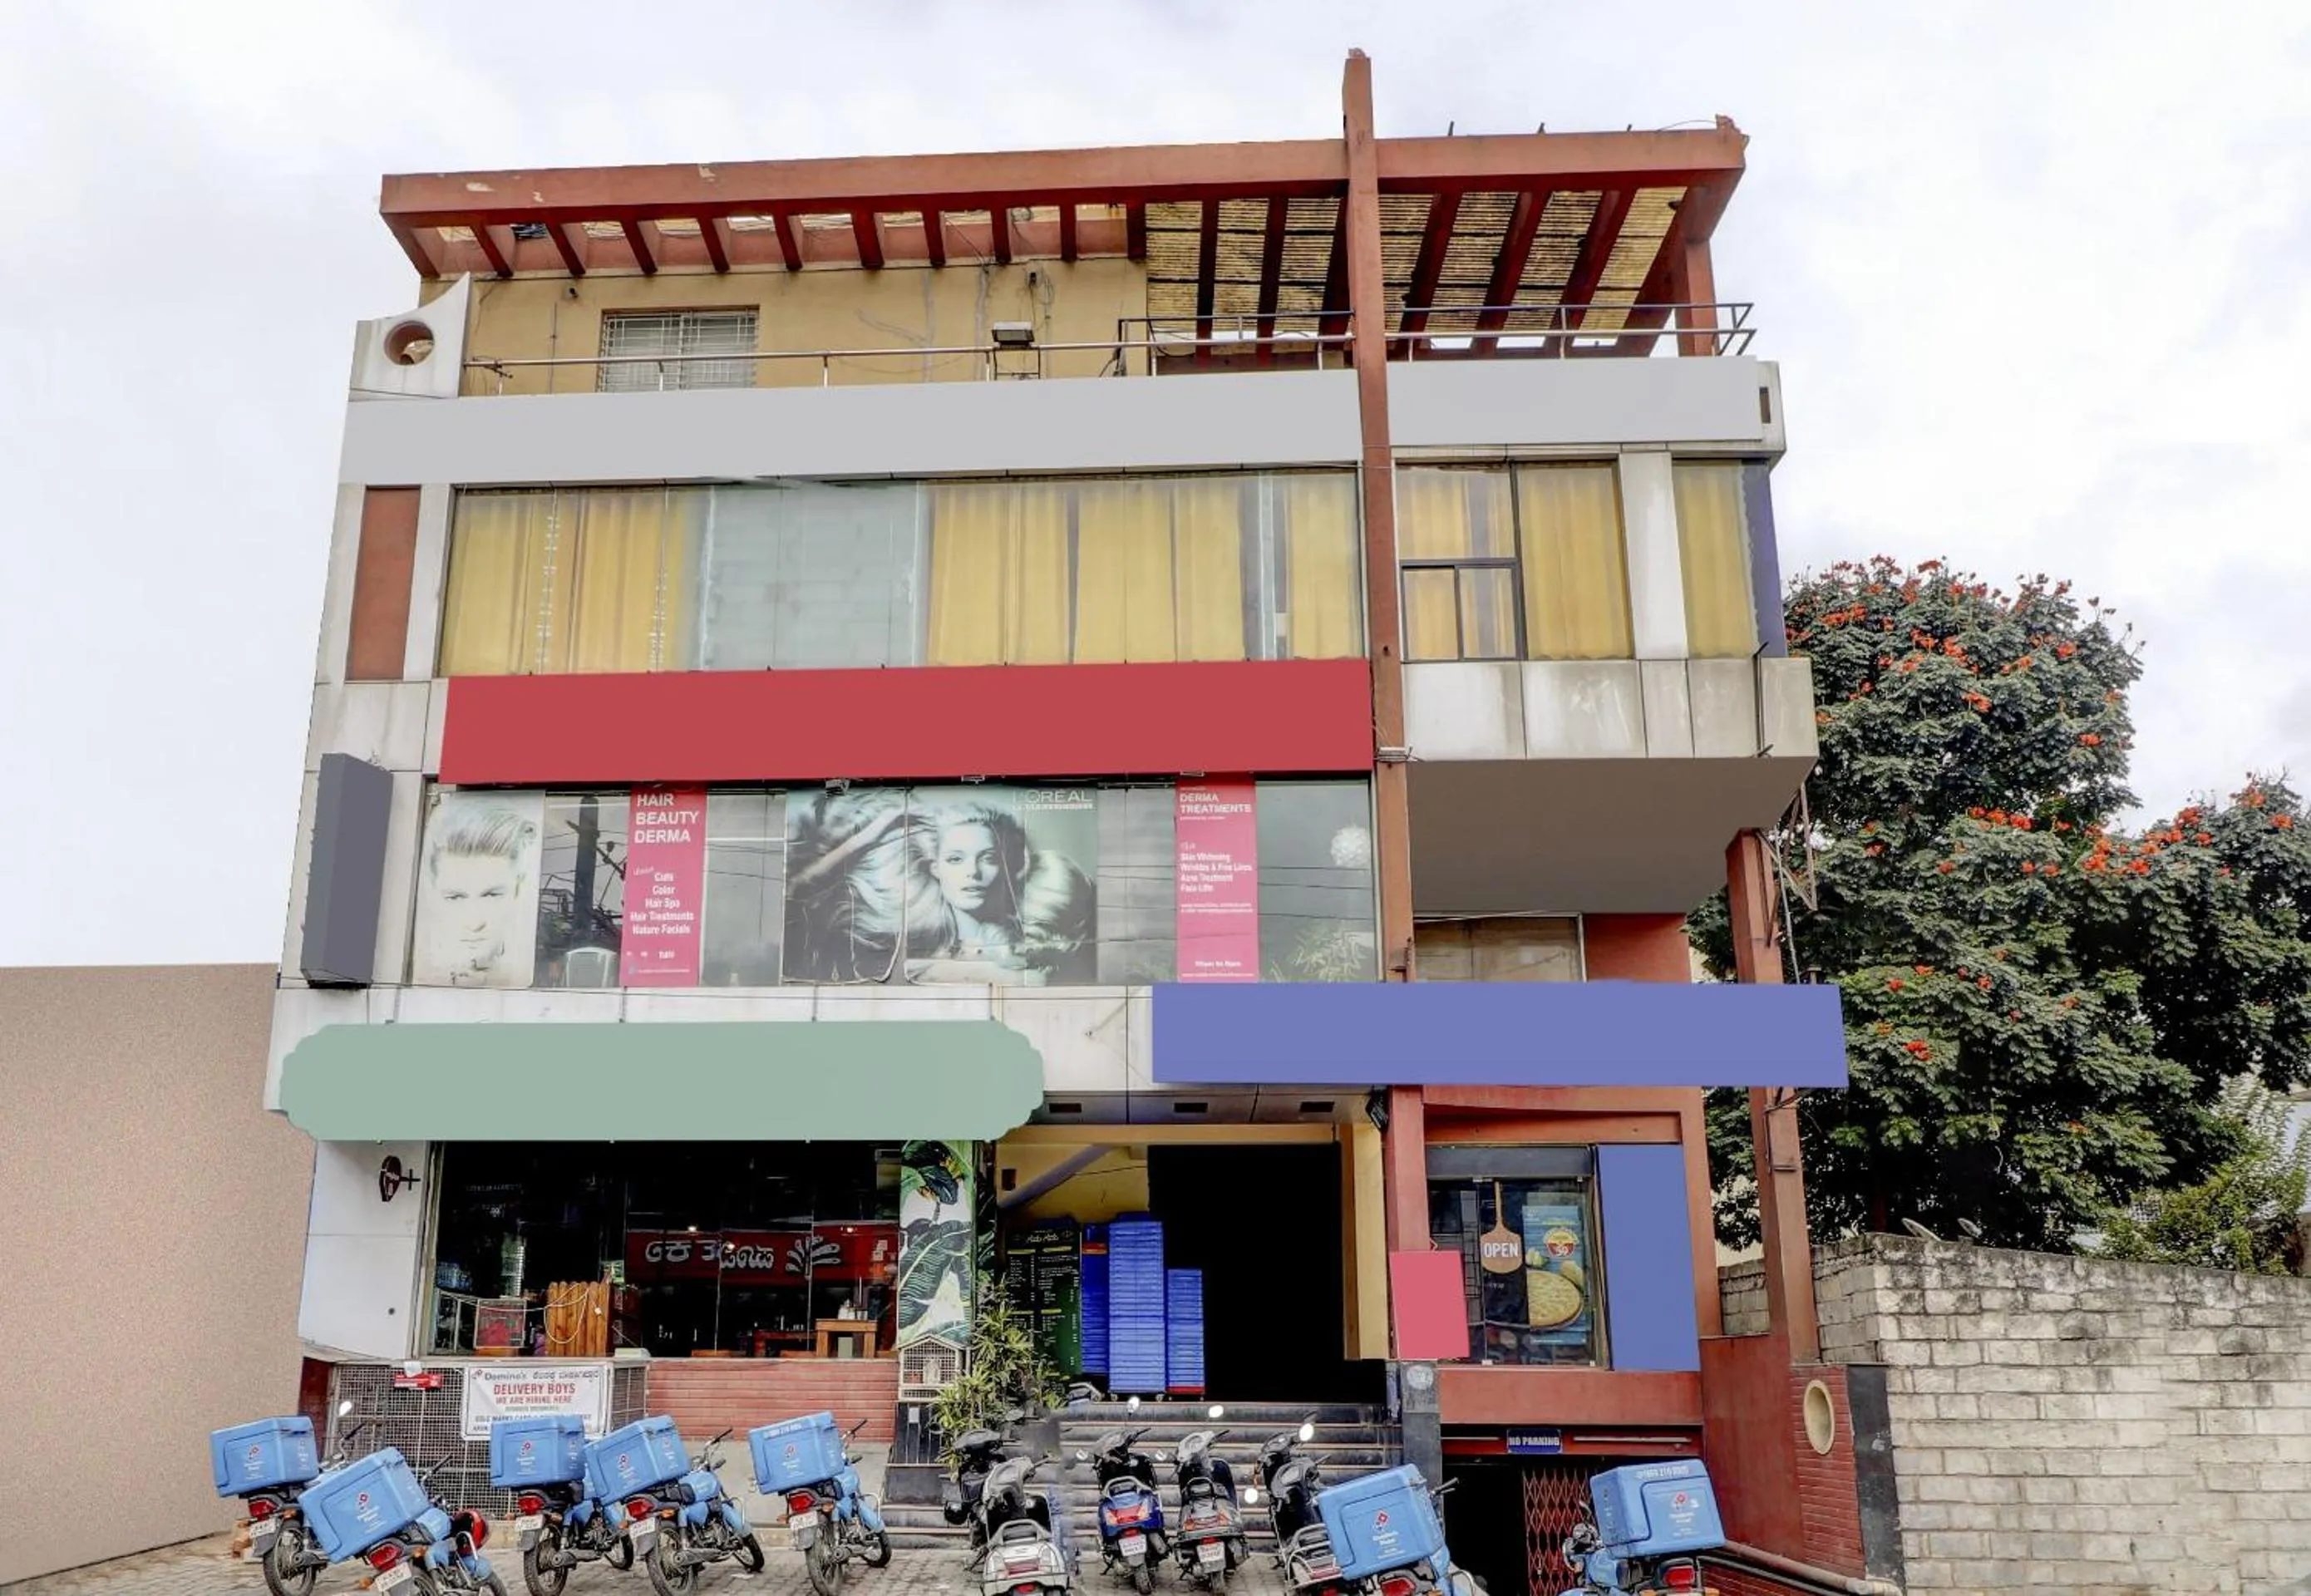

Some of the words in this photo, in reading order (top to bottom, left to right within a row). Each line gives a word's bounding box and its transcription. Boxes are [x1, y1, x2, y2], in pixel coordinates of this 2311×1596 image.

[637, 793, 675, 806] HAIR
[1180, 792, 1220, 802] DERMA
[1180, 803, 1251, 813] TREATMENTS
[636, 810, 699, 825] BEAUTY
[634, 829, 691, 843] DERMA
[653, 885, 675, 895] Color
[645, 898, 663, 909] Hair
[664, 898, 680, 909] Spa
[648, 911, 694, 921] Treatments
[1484, 1243, 1519, 1257] OPEN
[494, 1383, 544, 1395] DELIVERY
[548, 1382, 576, 1394] BOYS
[1509, 1436, 1521, 1446] NO
[1522, 1436, 1560, 1446] PARKING
